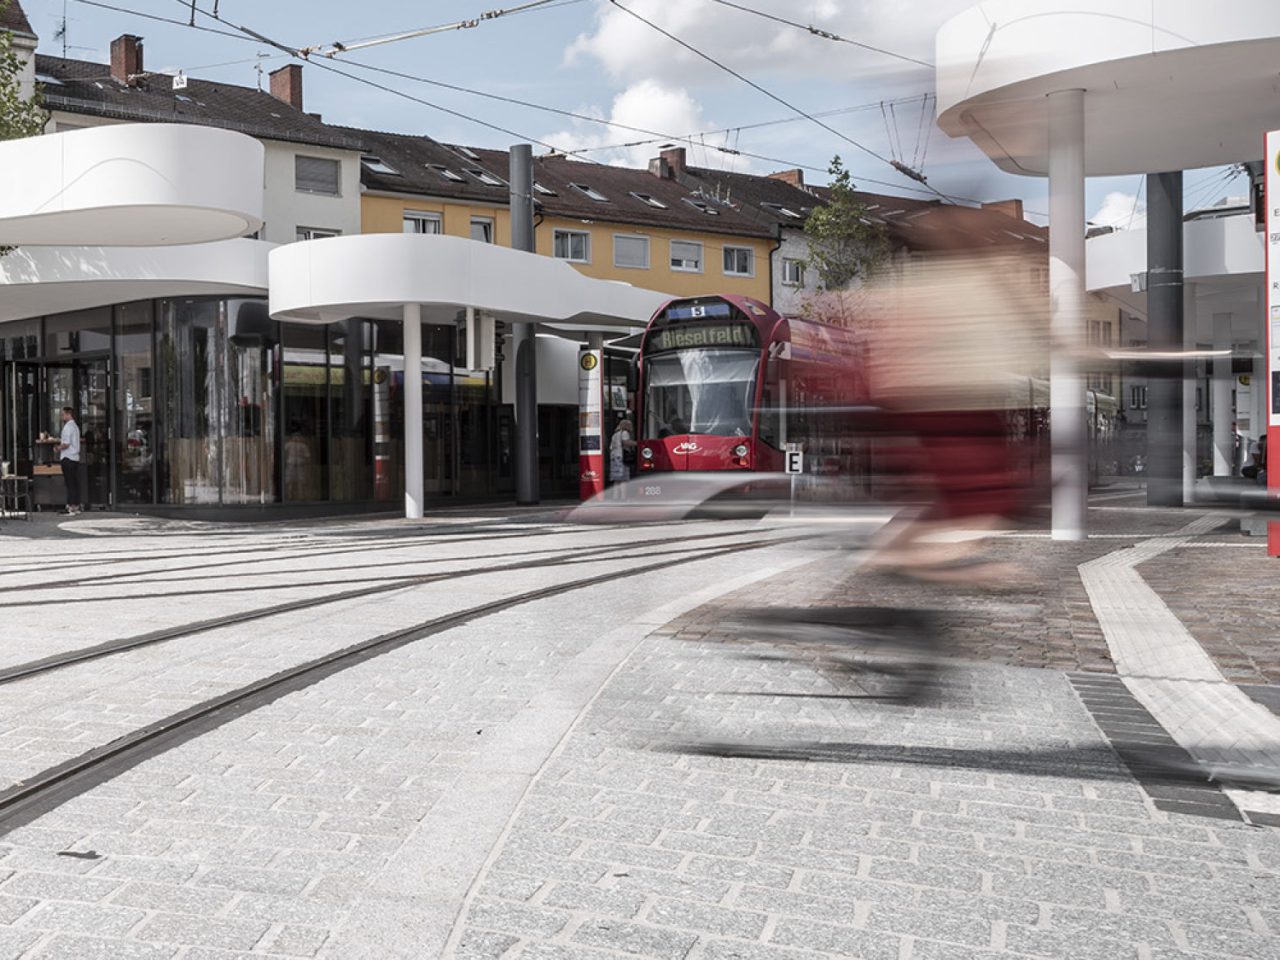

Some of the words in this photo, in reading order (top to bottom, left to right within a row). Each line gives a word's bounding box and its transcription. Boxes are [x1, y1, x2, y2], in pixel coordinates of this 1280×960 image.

[694, 307, 703, 316] 5
[662, 325, 743, 348] Rieselfeld
[789, 453, 800, 472] E
